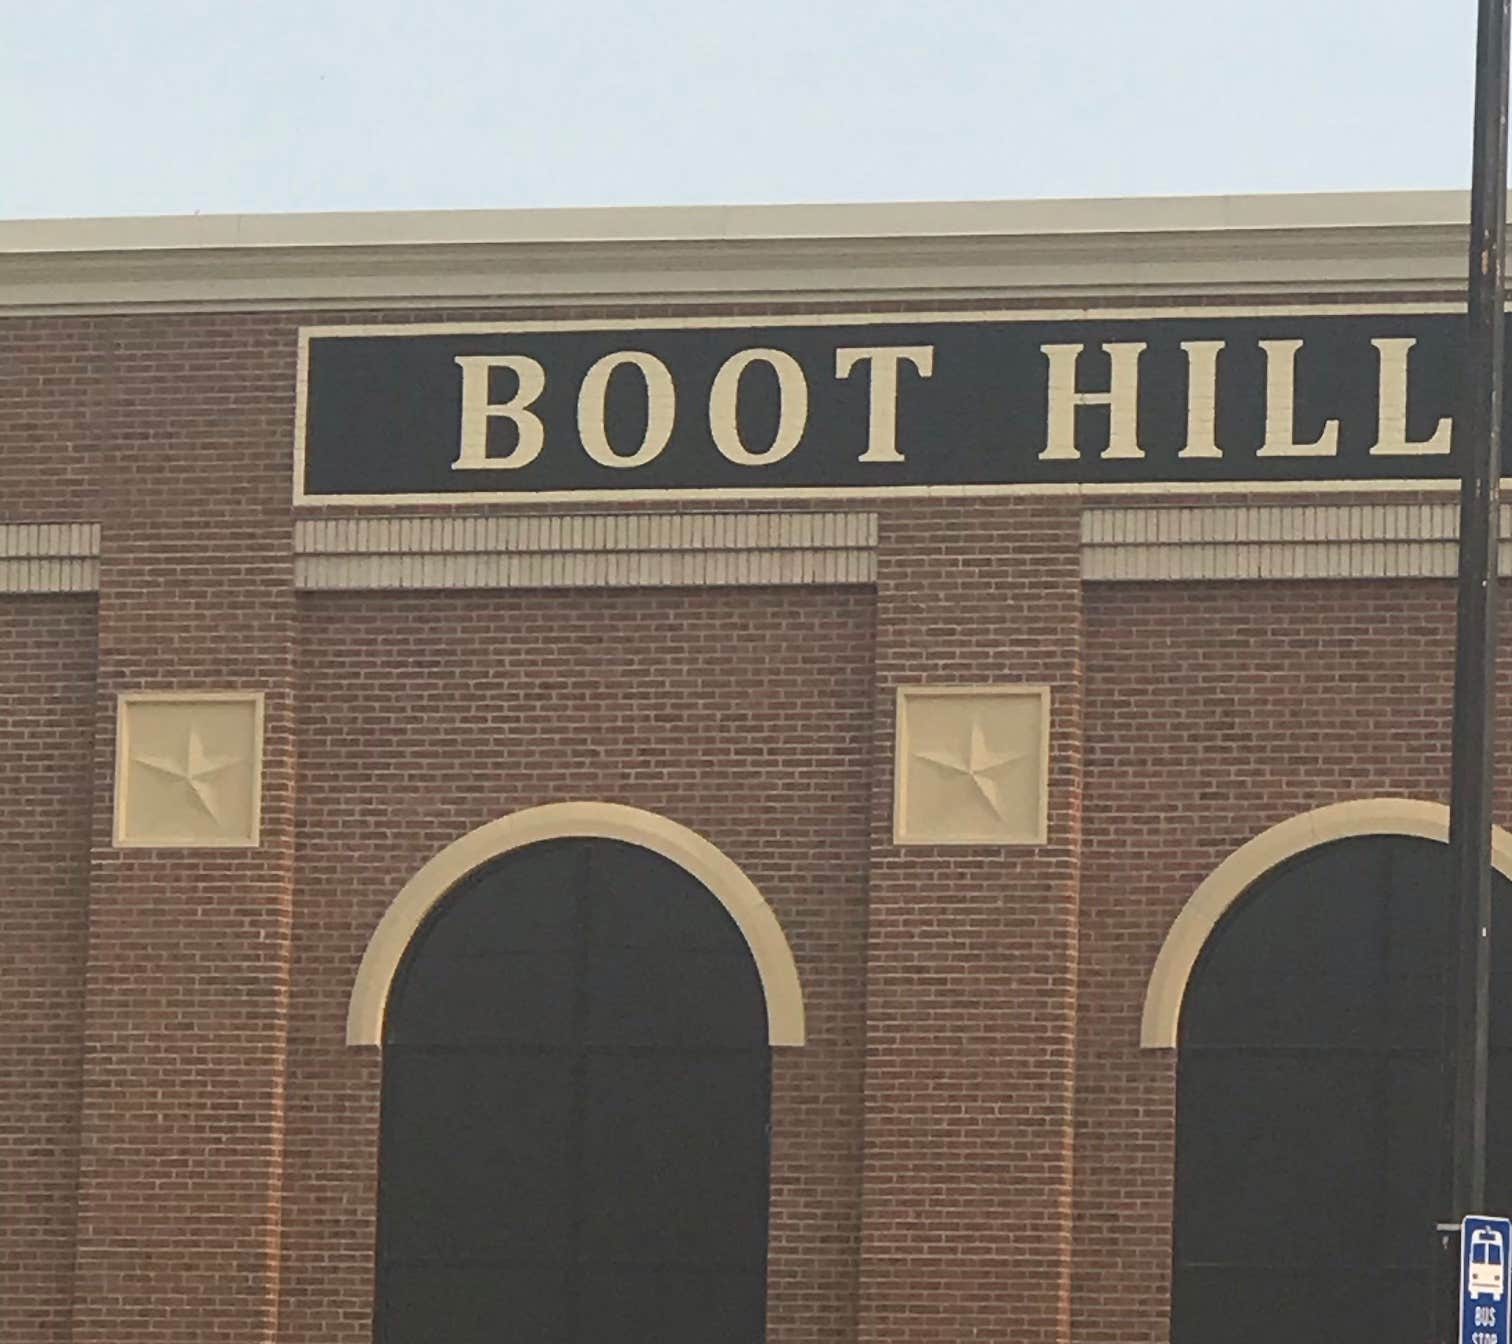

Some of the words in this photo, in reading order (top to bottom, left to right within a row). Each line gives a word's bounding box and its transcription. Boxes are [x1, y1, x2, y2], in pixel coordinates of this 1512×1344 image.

[450, 344, 935, 470] BOOT
[1038, 338, 1454, 460] HILL
[1475, 1306, 1497, 1327] BUS
